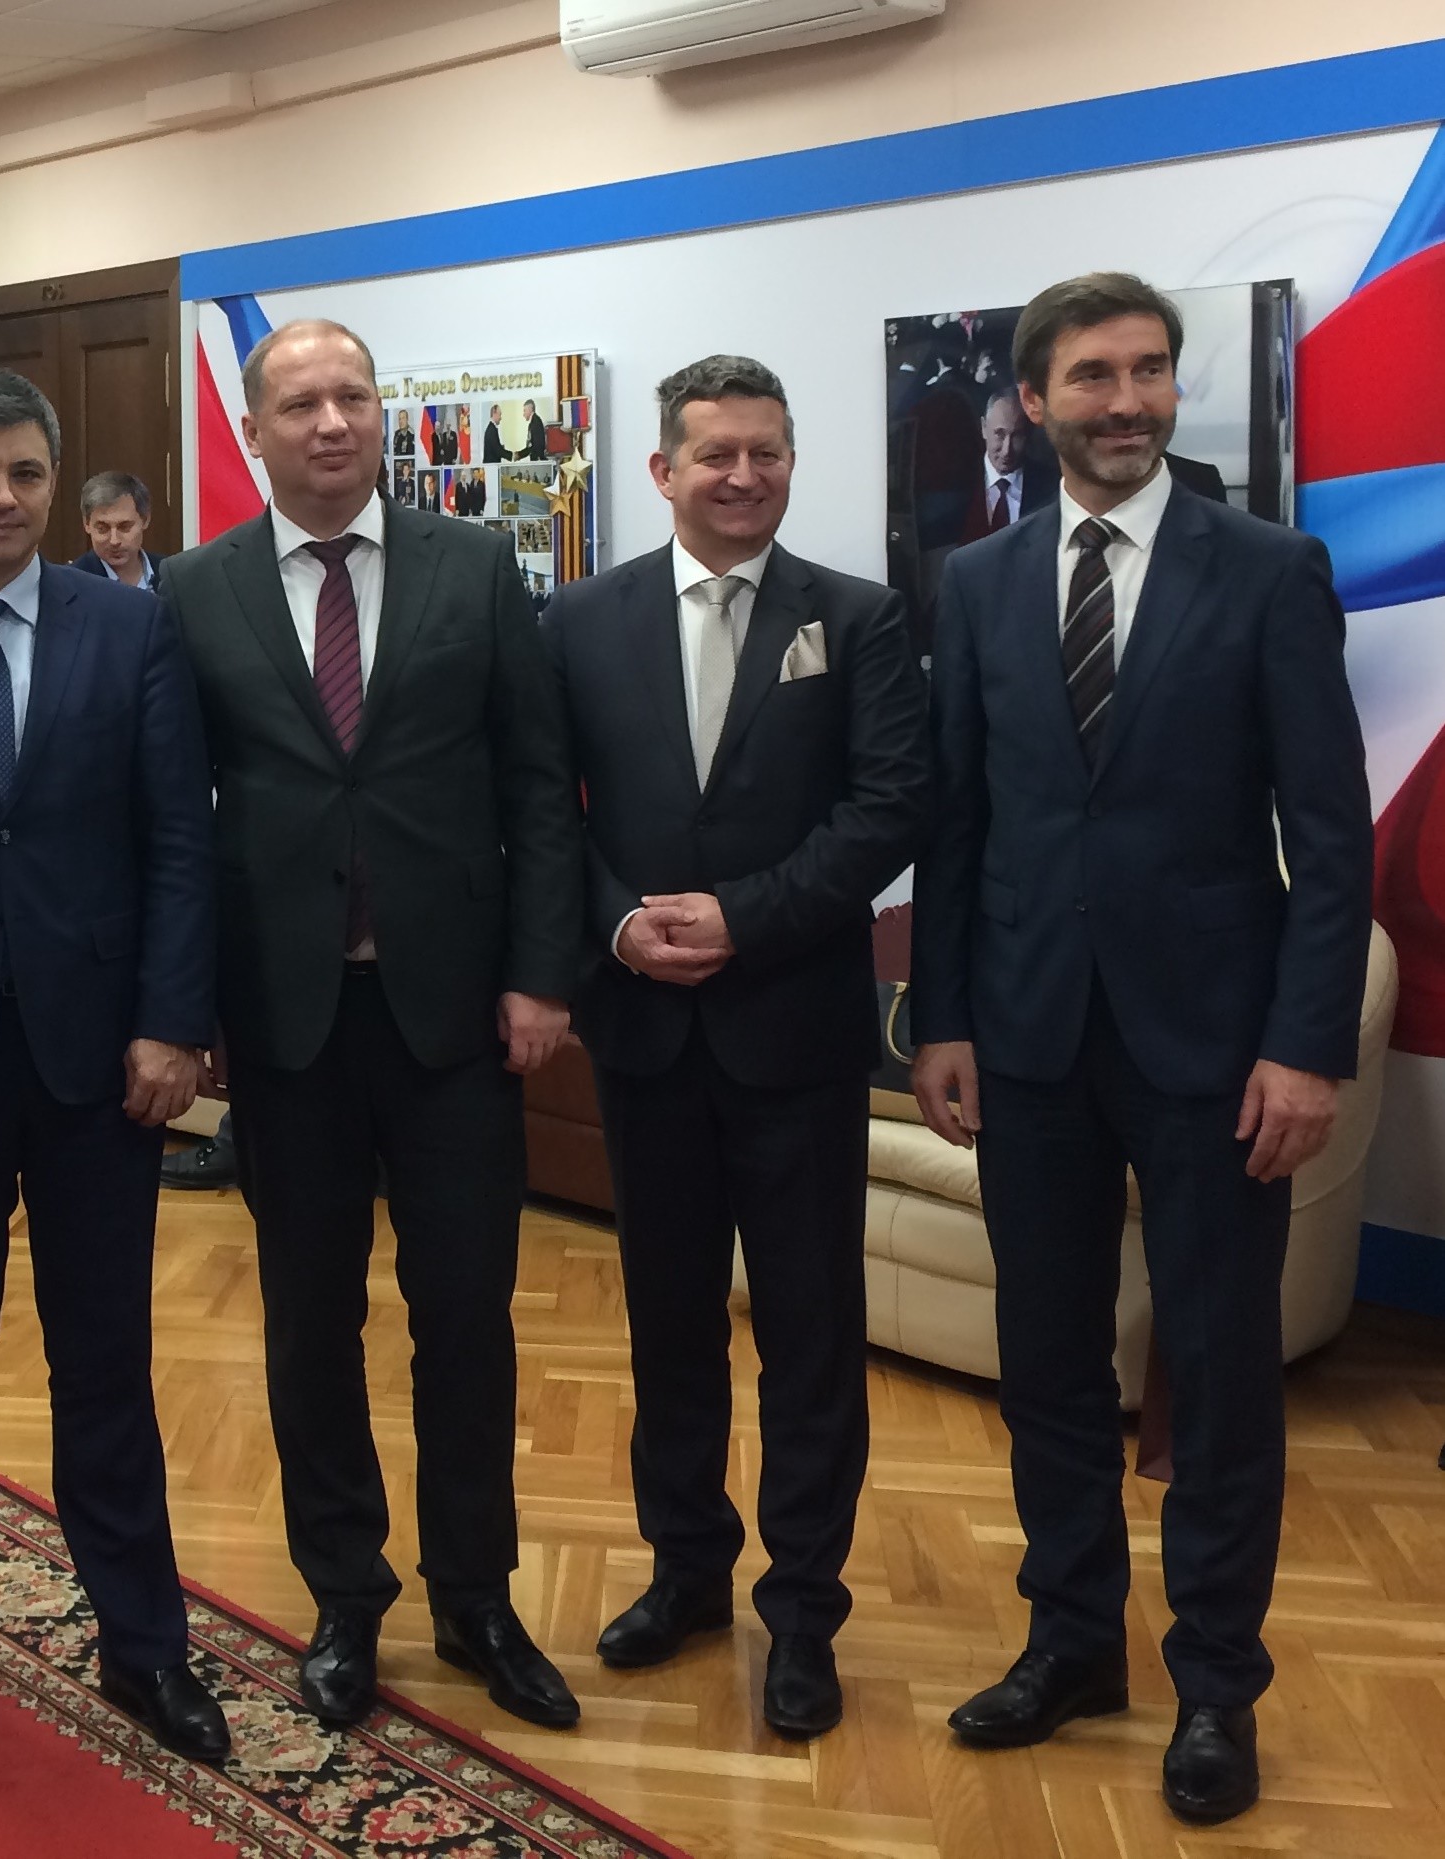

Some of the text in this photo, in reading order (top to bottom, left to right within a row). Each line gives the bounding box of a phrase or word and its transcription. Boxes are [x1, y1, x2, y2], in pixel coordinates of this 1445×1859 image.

[377, 371, 543, 401] ень Героев Отечества
